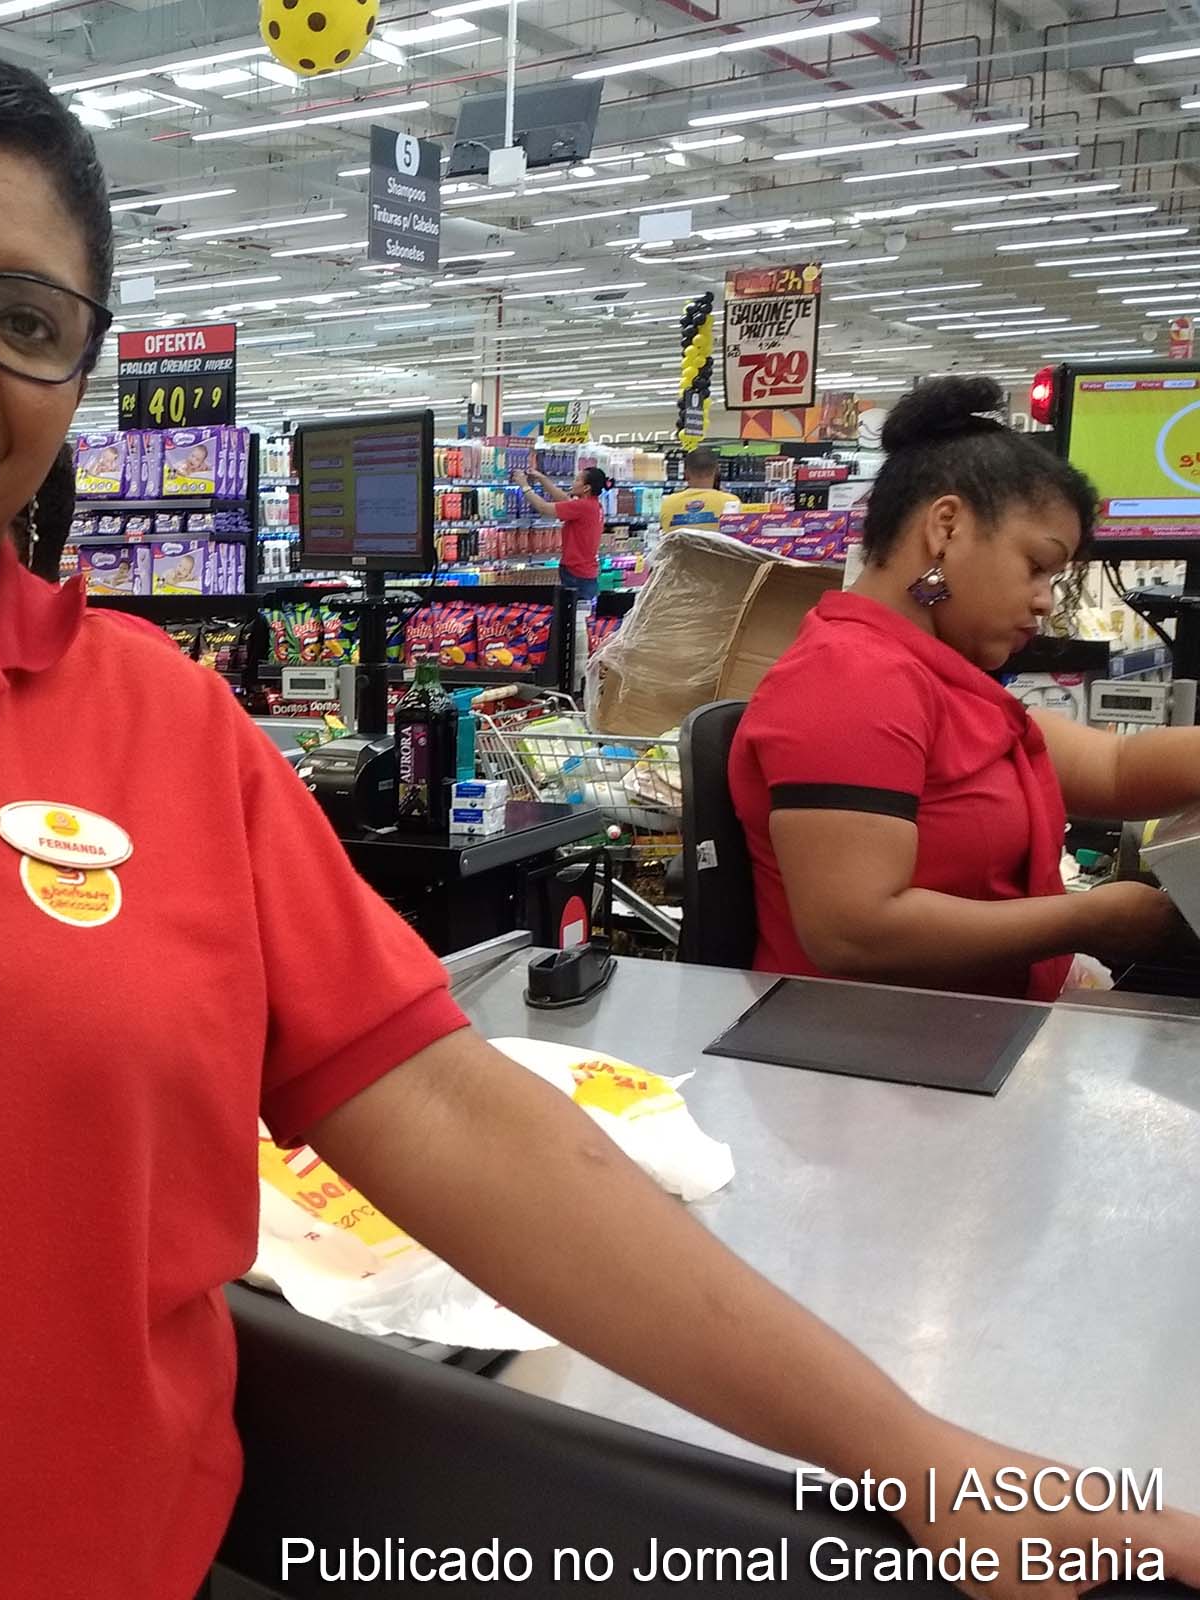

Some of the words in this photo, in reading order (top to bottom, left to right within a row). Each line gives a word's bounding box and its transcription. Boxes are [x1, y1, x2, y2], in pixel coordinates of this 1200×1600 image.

[403, 140, 412, 168] 5
[387, 176, 426, 202] Shampoos
[373, 204, 402, 227] Tinturas
[402, 212, 413, 231] p/
[412, 214, 440, 236] Cabelos
[386, 238, 425, 262] Sabonetes
[731, 299, 812, 326] SABONETE
[144, 331, 207, 354] OFERTA
[120, 361, 158, 376] FRALDA
[160, 358, 202, 374] CREMER
[738, 350, 809, 402] 7,99
[122, 393, 136, 412] R$
[272, 704, 308, 718] Doritos
[400, 726, 413, 783] AURORA
[38, 837, 107, 857] FERNANDA
